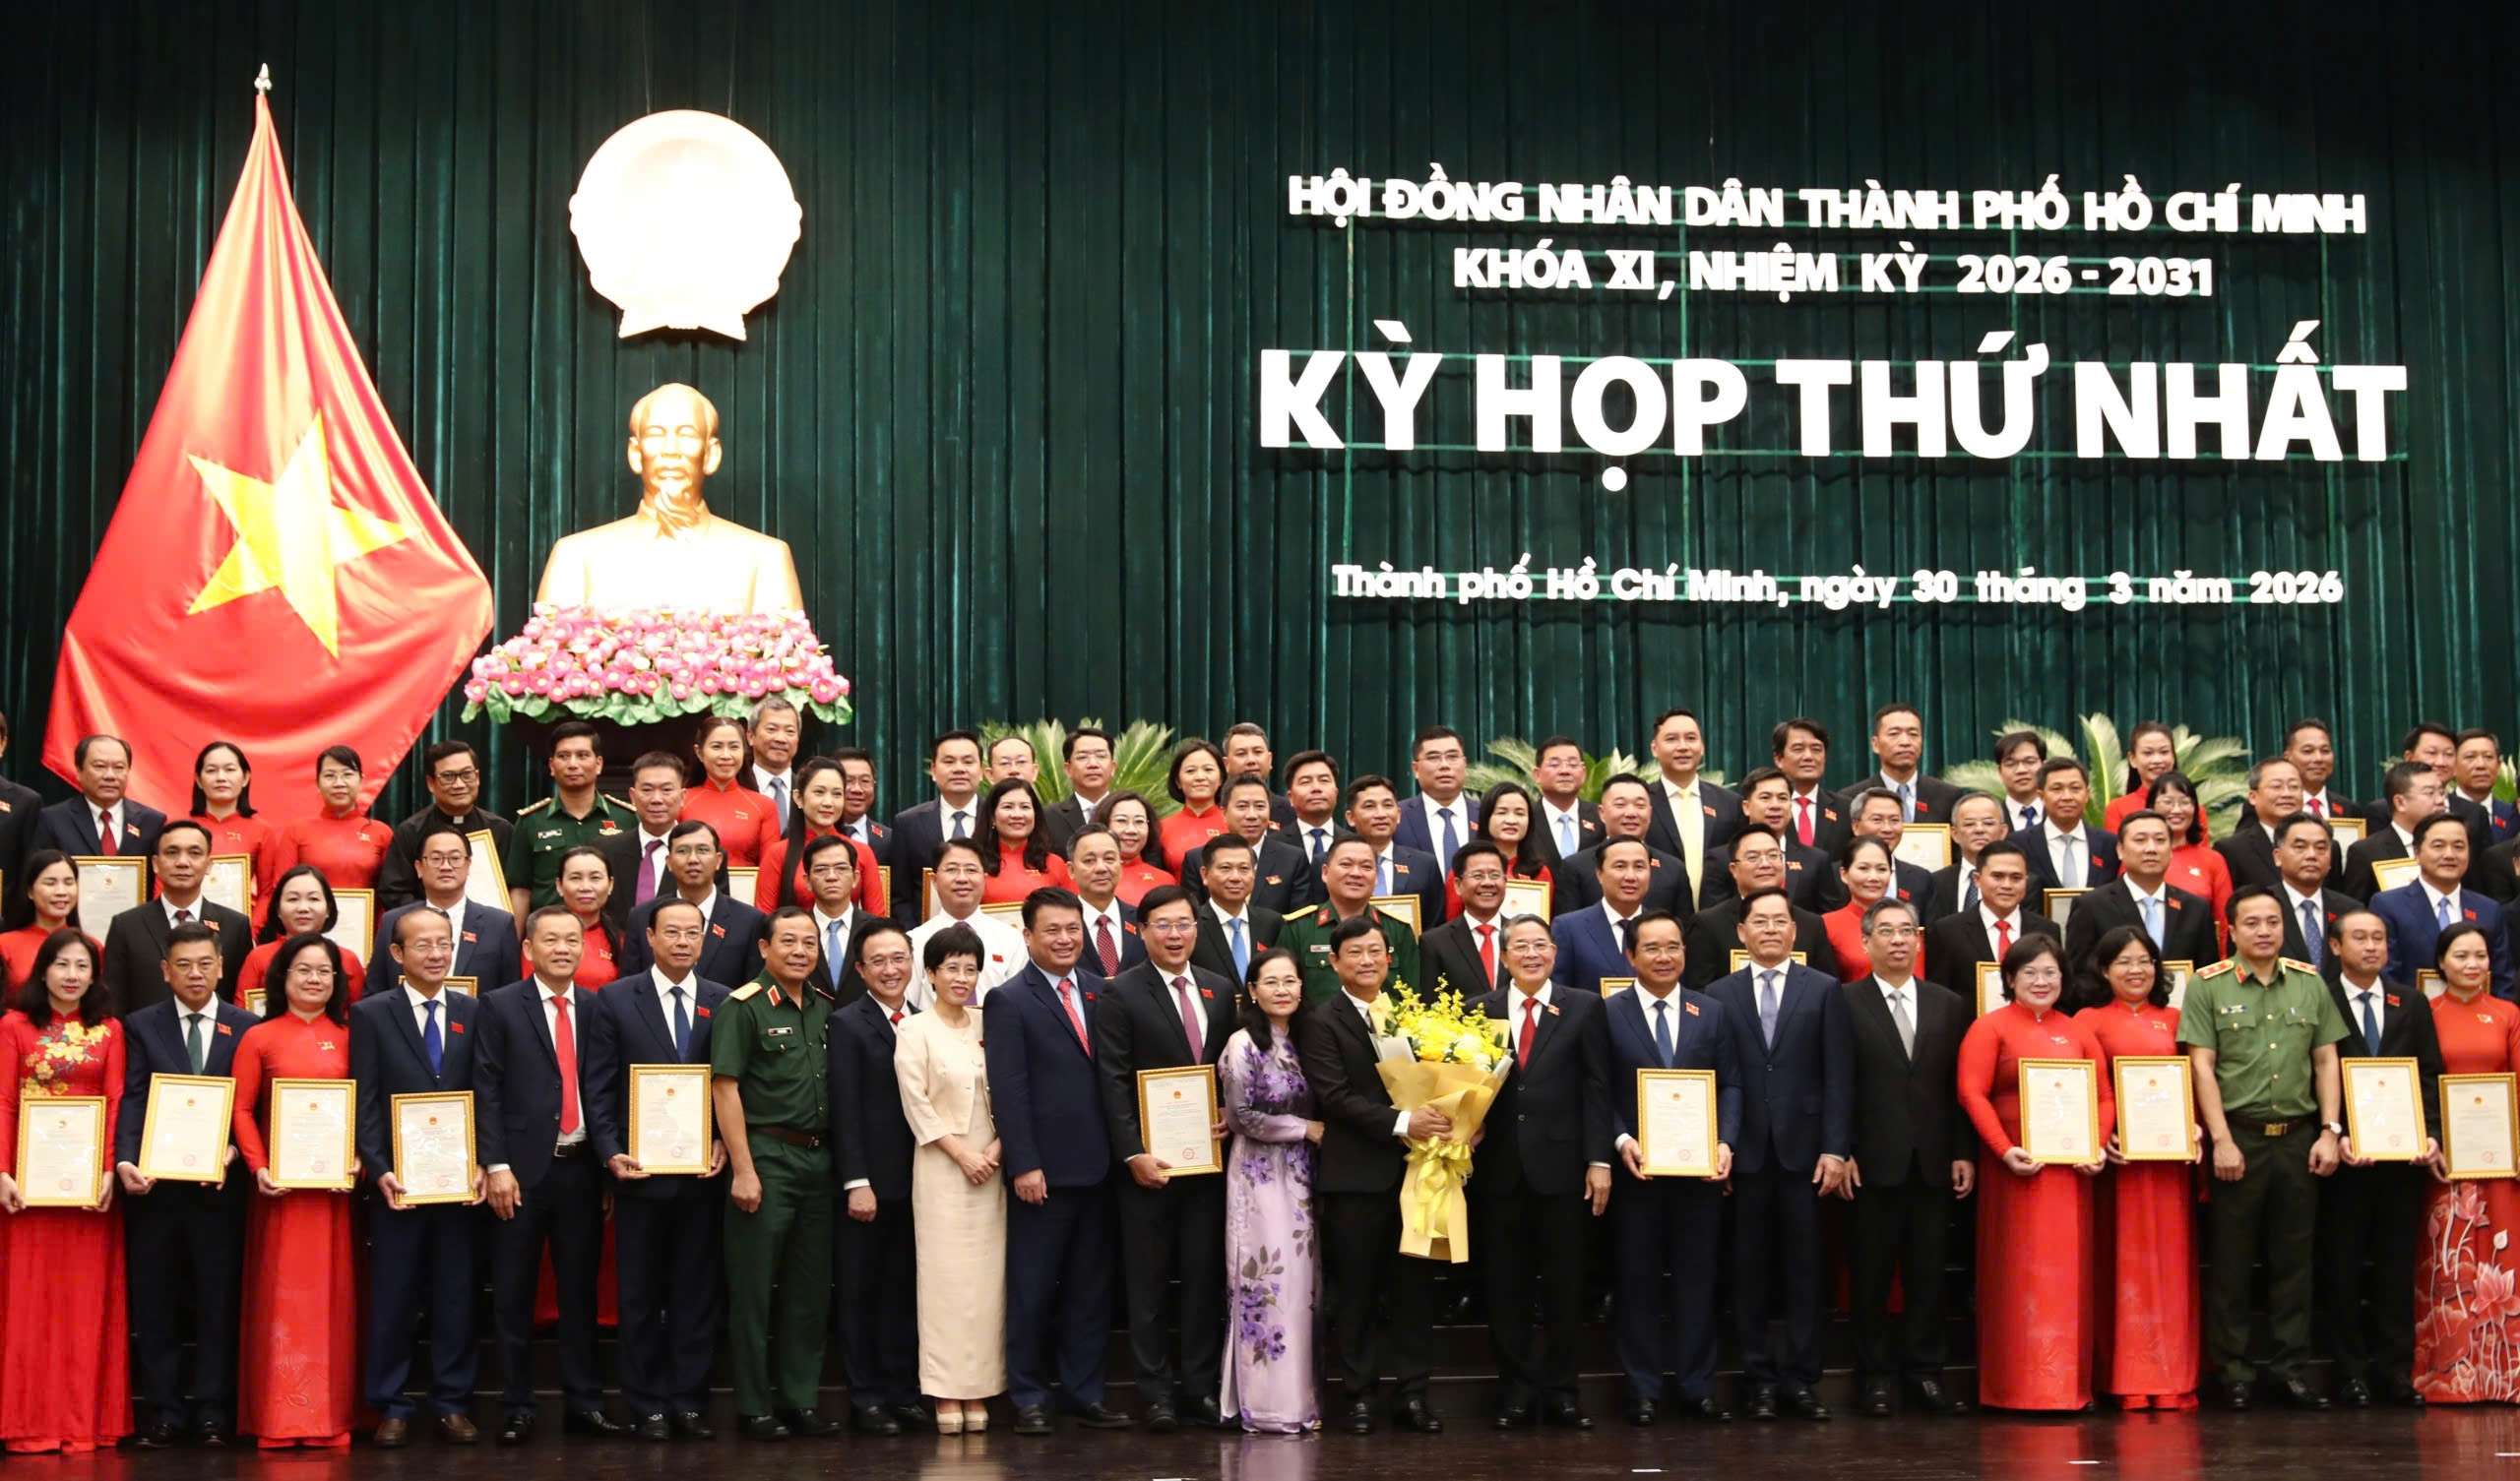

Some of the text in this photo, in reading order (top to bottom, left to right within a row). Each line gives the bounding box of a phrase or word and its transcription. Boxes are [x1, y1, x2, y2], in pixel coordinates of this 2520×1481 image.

[1289, 162, 2366, 234] HỘI ĐỒNG NHÂN DÂN THÀNH PHỐ HỒ CHÍ MINH
[1454, 238, 1593, 289] KHÓA
[1689, 242, 1839, 303] NHIỆM
[1860, 241, 1928, 293] KỲ
[1956, 254, 2072, 294] 2026
[2108, 256, 2212, 297] 2031
[1260, 319, 2407, 492] KỲ HỌP THỨ NHẤT
[1332, 552, 2344, 612] Thành phố Hồ Chí Minh, ngày 30 tháng 3 năm 2026
